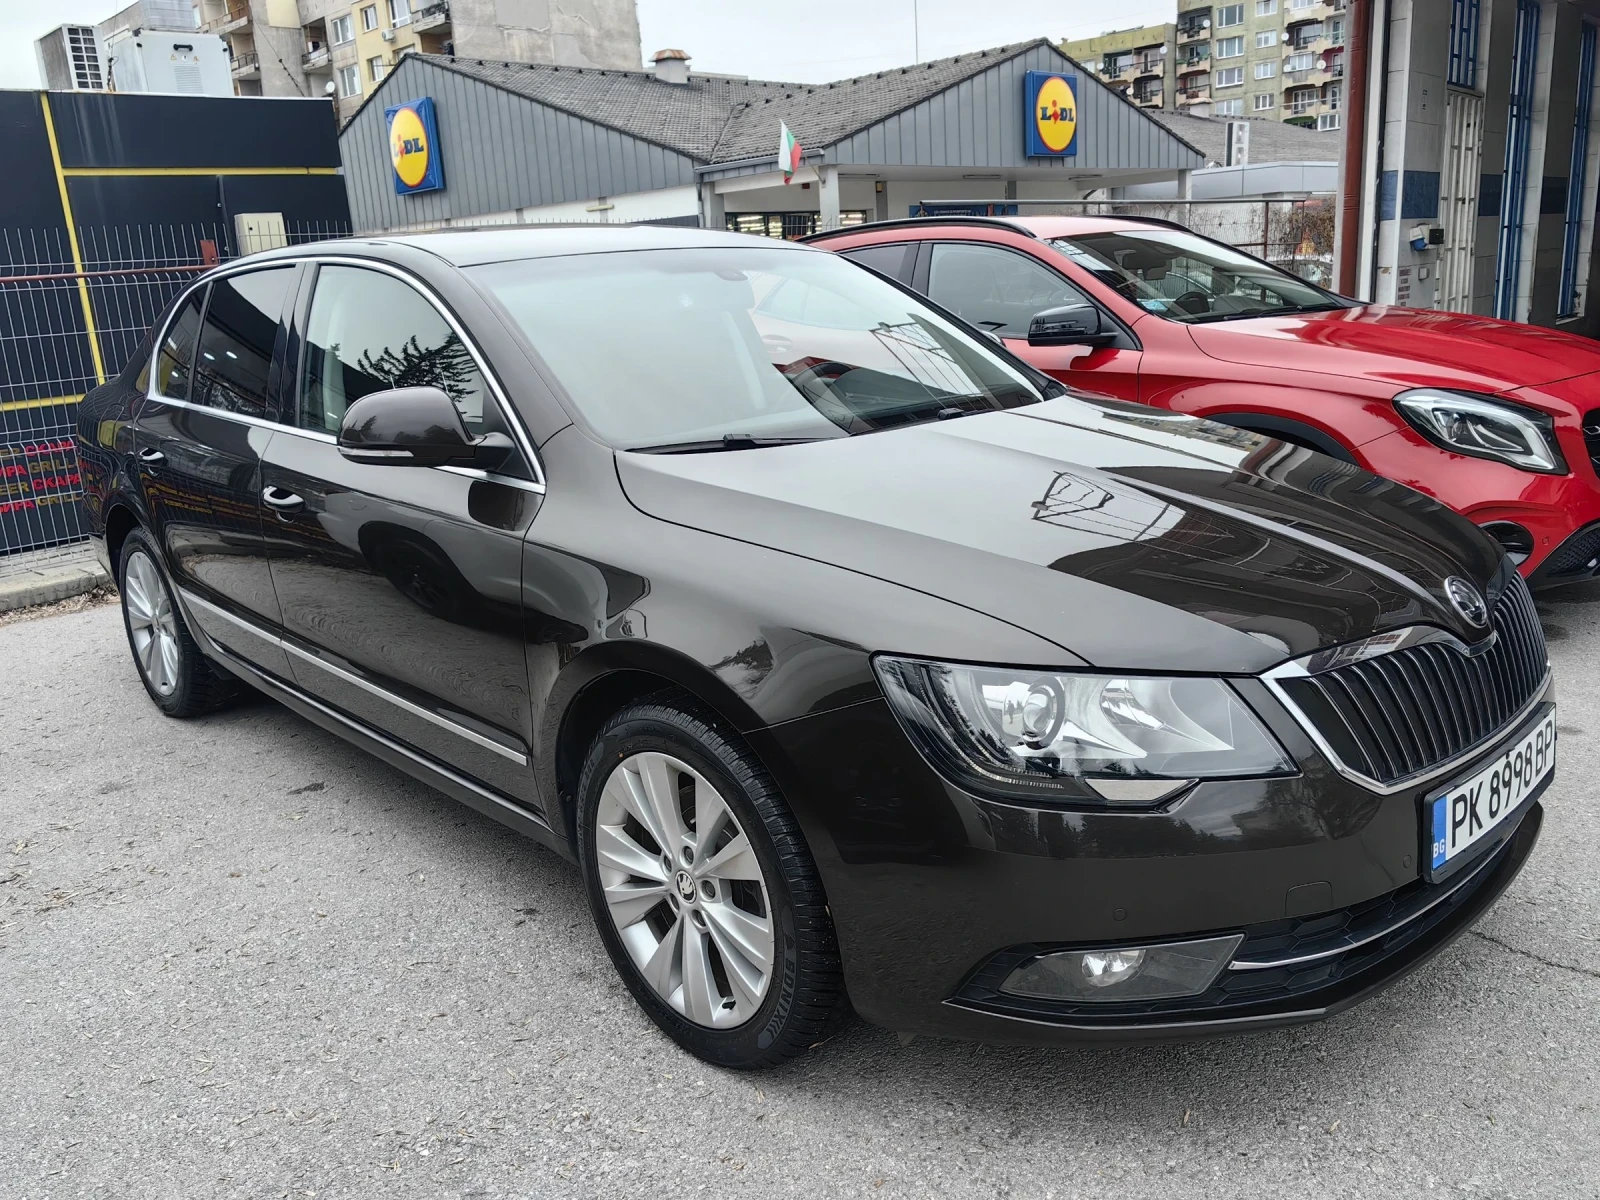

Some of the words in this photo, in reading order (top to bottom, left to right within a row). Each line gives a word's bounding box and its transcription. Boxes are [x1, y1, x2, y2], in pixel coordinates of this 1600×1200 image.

[1433, 838, 1446, 858] BG
[1452, 780, 1483, 848] PK
[1489, 741, 1533, 819] 8998
[1535, 719, 1553, 778] BP
